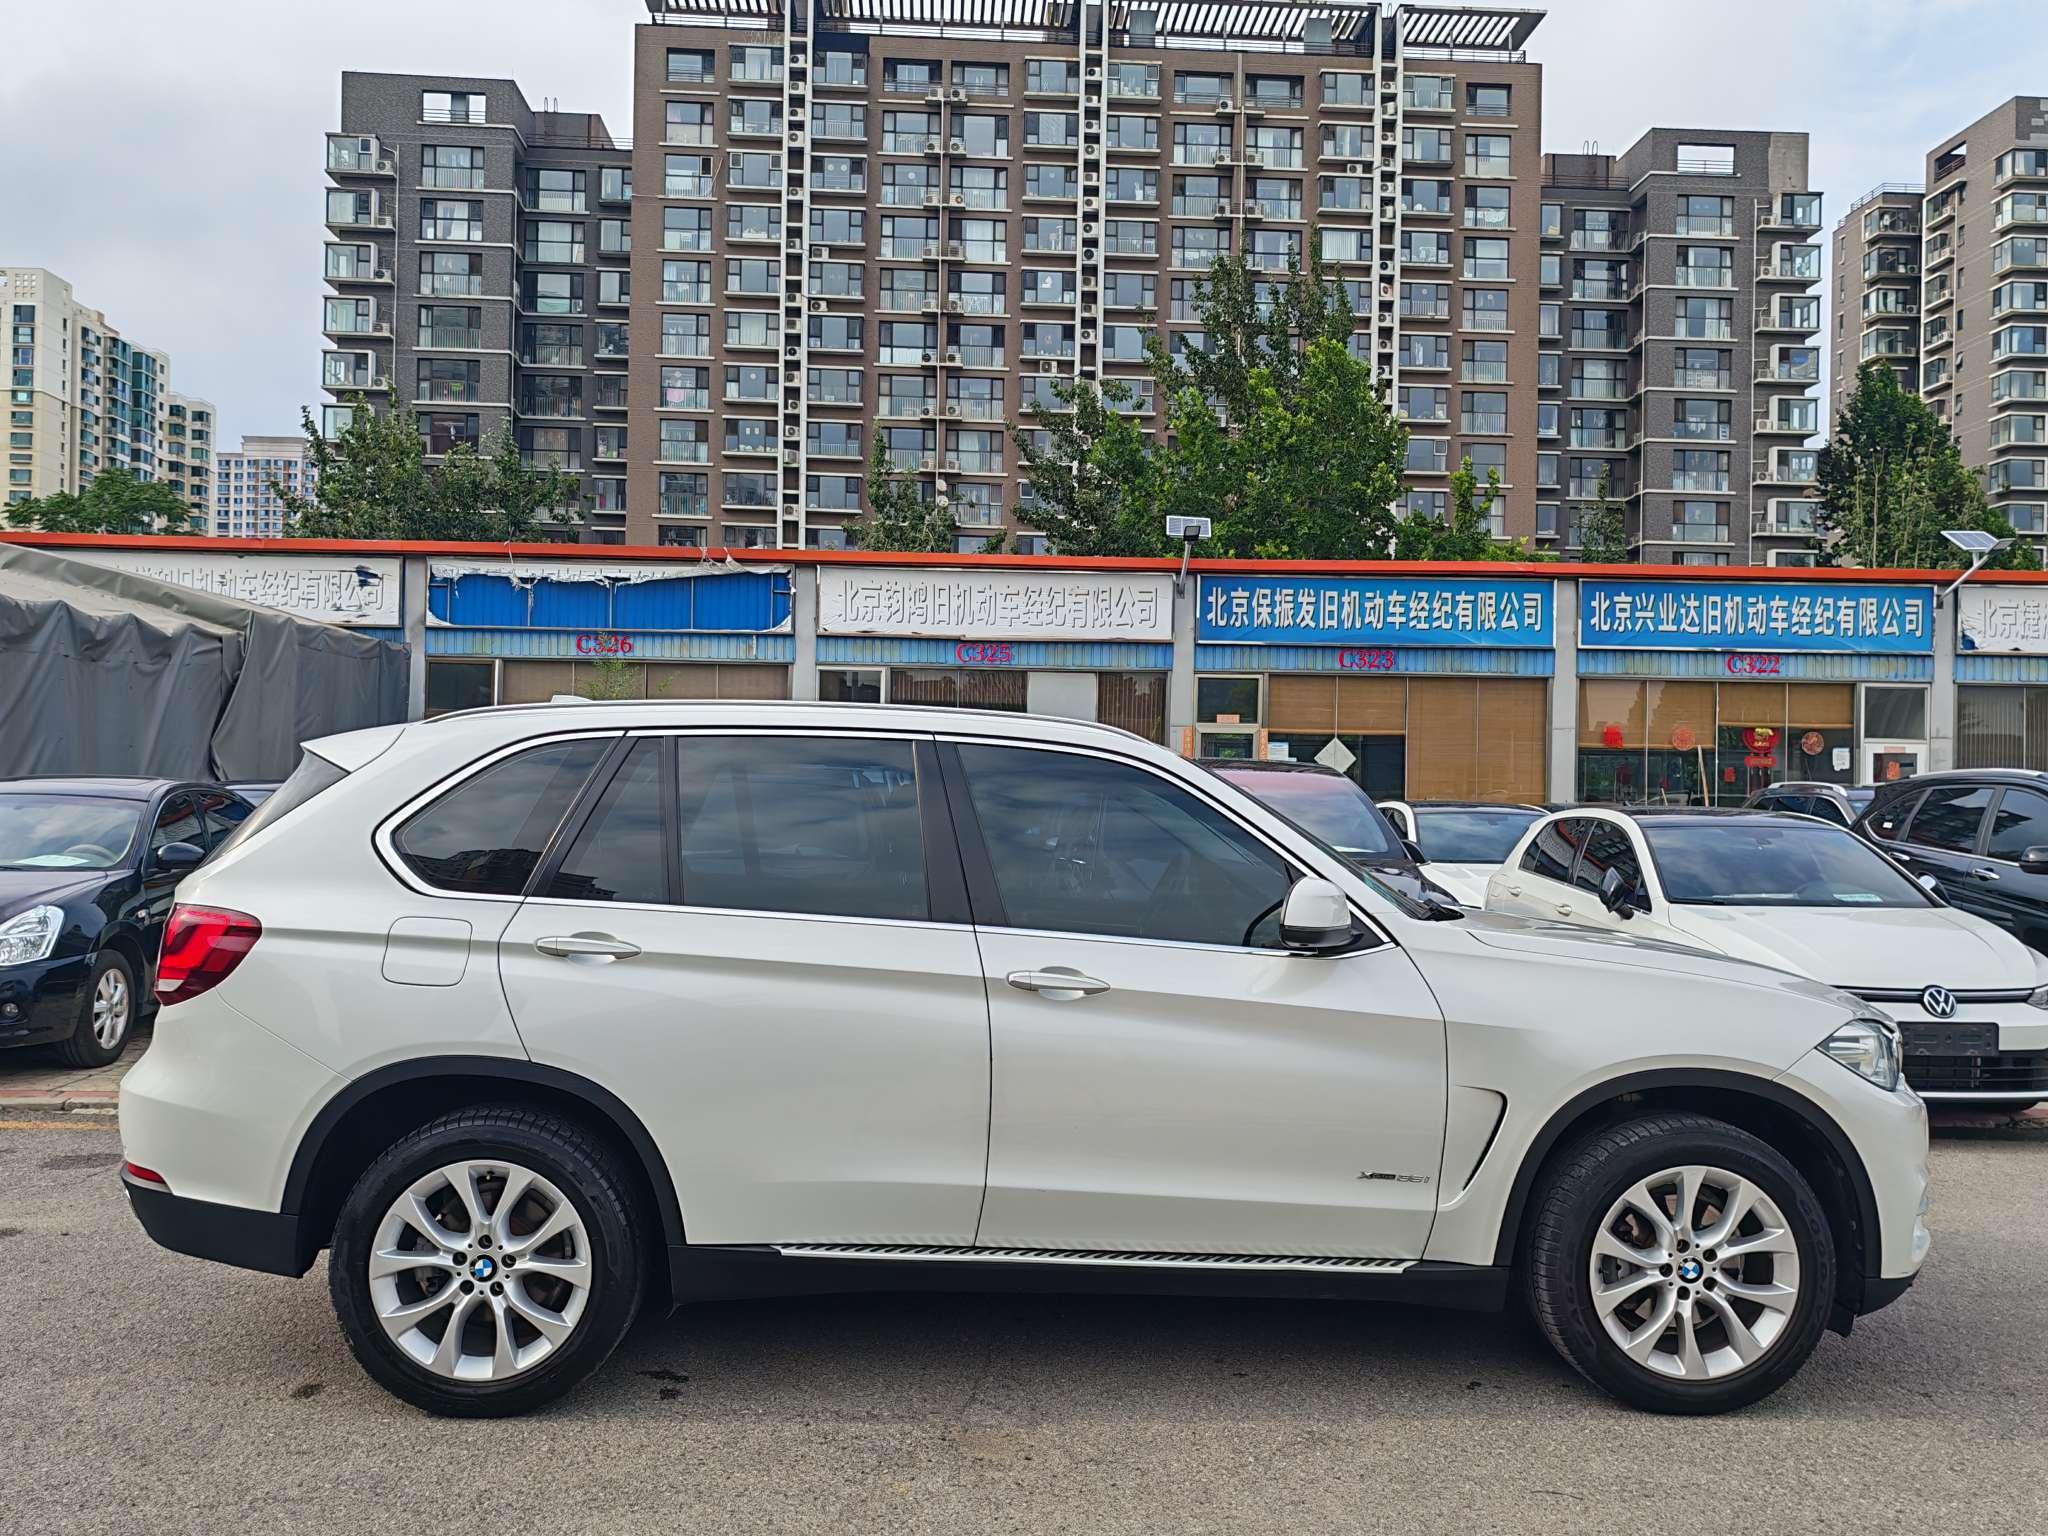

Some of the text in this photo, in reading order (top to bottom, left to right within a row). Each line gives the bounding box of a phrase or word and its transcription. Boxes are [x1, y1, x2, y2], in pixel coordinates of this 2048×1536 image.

[1207, 587, 1542, 631] 北京保振发旧机动车经纪有限公司
[1590, 592, 1923, 637] 北京兴业达旧机动车经纪有限公司
[1977, 597, 2048, 640] 北京捷
[955, 643, 1011, 663] C325
[1337, 648, 1393, 669] C323
[1727, 655, 1780, 673] C322
